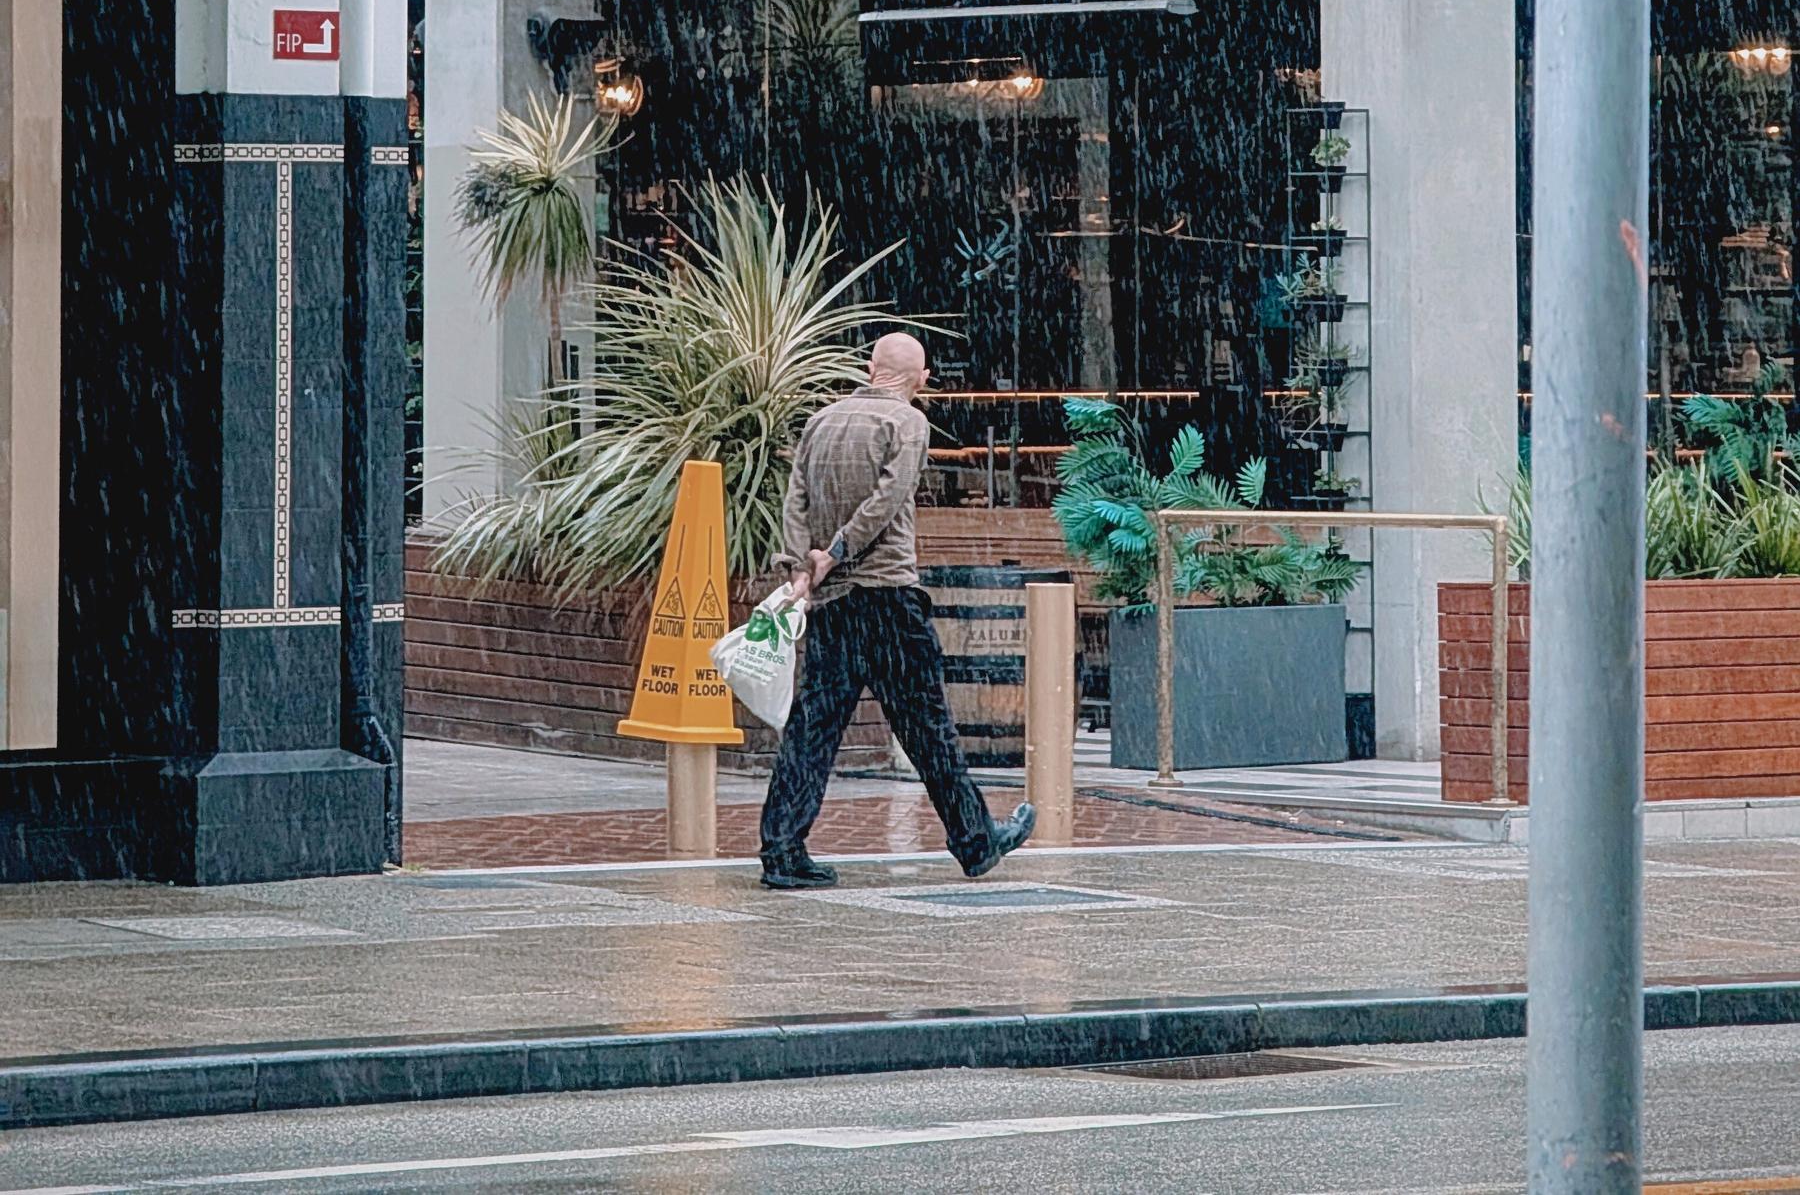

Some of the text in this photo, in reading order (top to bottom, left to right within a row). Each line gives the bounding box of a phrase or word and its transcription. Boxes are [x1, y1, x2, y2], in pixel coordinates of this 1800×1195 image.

[277, 33, 302, 53] FIP
[652, 617, 686, 639] CAUTION
[692, 621, 725, 640] CAUTION
[651, 664, 675, 679] WET
[695, 668, 719, 681] WET
[641, 678, 679, 695] FLOOR
[688, 684, 727, 697] FLOOR
